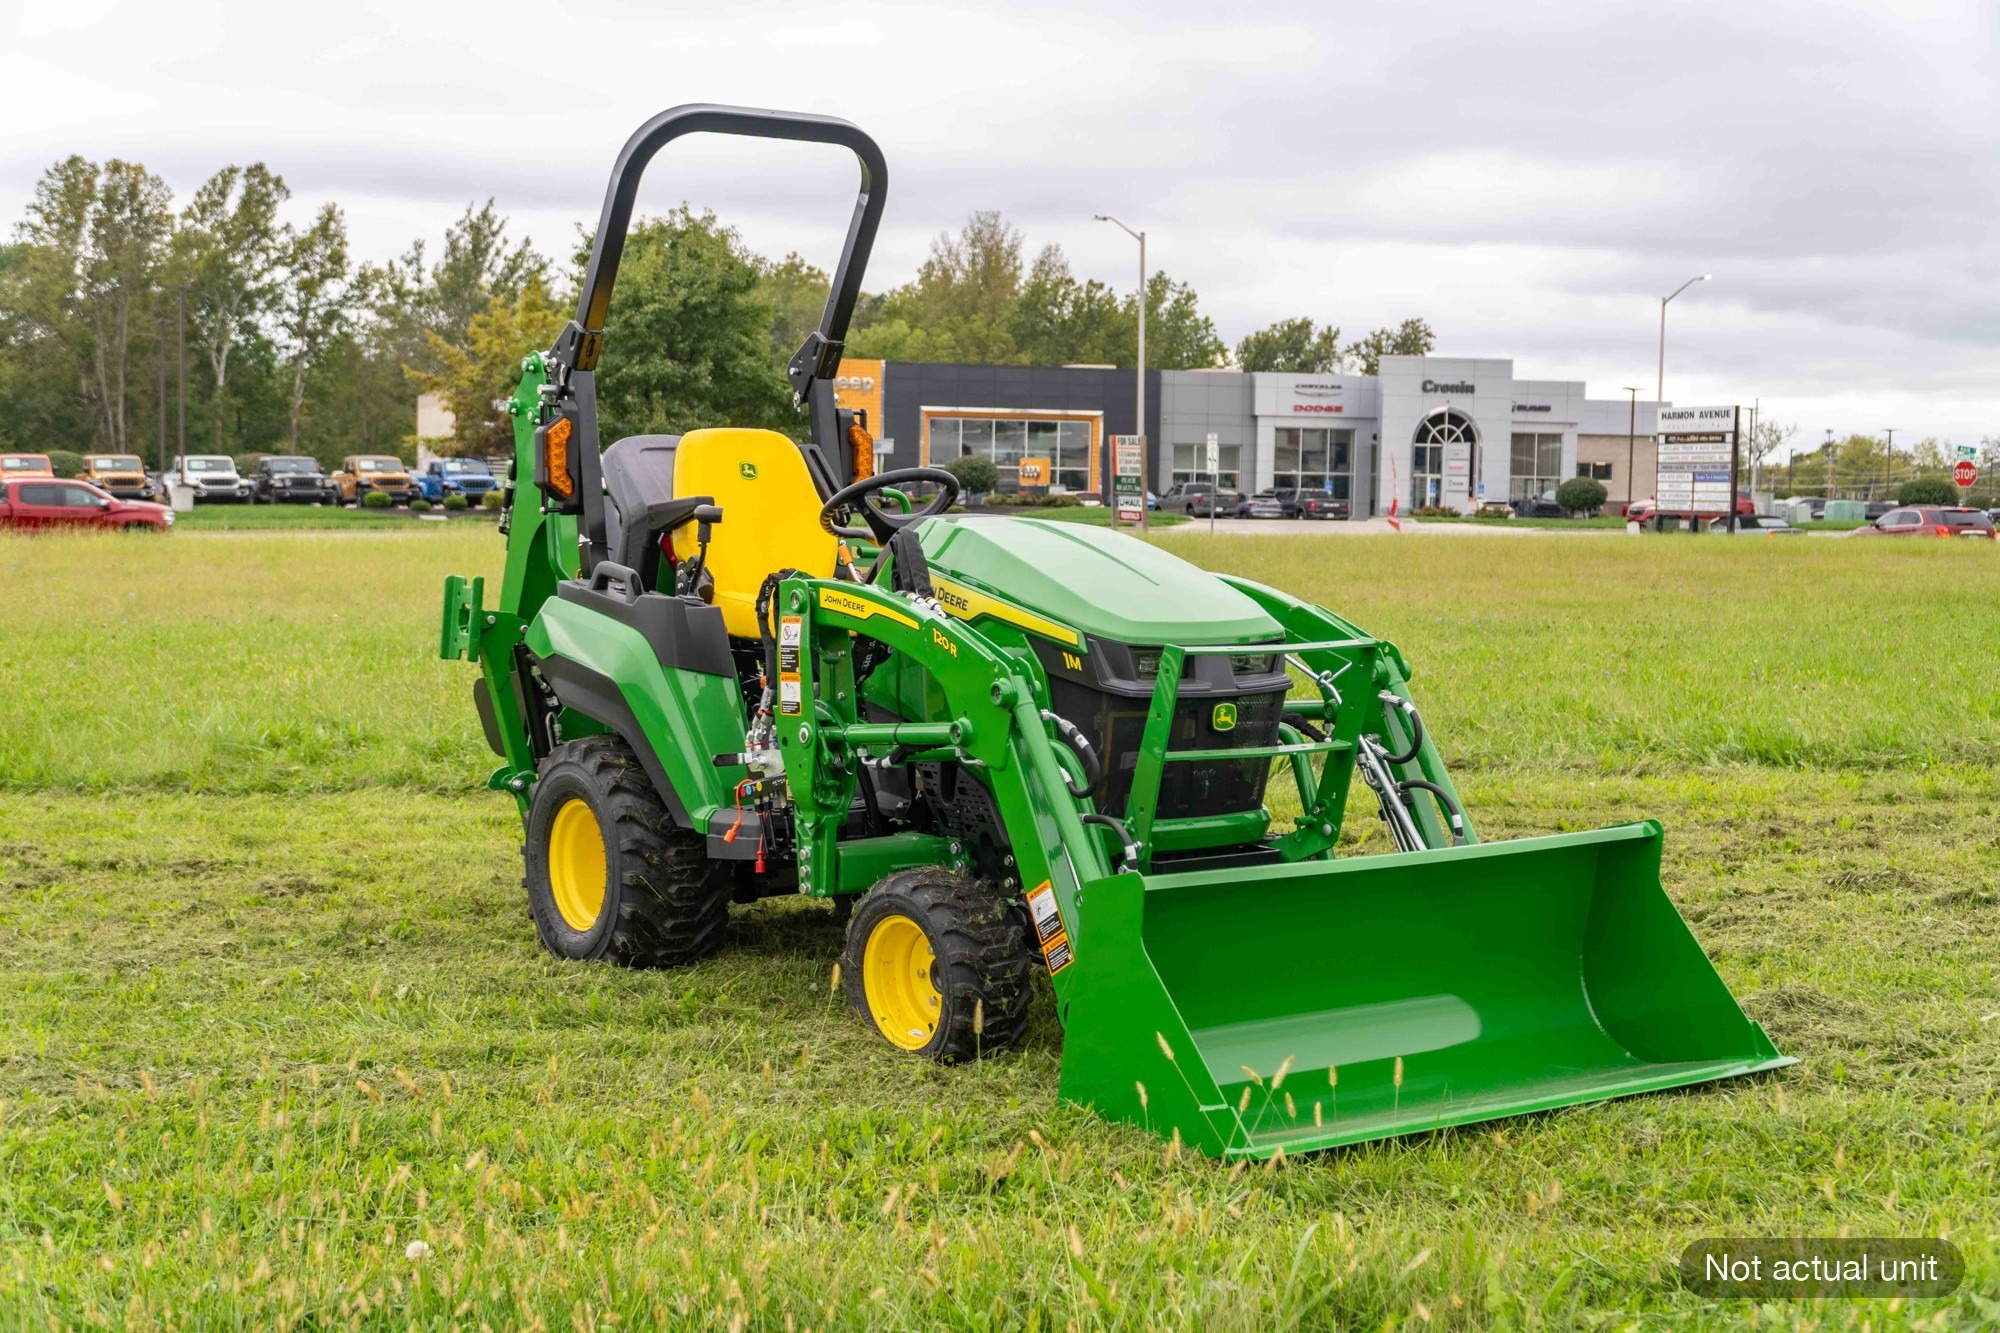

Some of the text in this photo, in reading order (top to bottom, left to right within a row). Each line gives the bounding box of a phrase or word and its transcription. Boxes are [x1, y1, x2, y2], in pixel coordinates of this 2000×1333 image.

[837, 376, 875, 393] eep
[1422, 380, 1475, 394] Cronin
[1294, 405, 1344, 413] DODGE
[1661, 409, 1731, 420] HARMON AVENUE
[1117, 437, 1141, 446] FOR SALE
[1955, 469, 1976, 480] STOP
[824, 593, 865, 612] JOHN DEERE
[938, 586, 969, 612] DEERE
[1062, 651, 1082, 671] 1M
